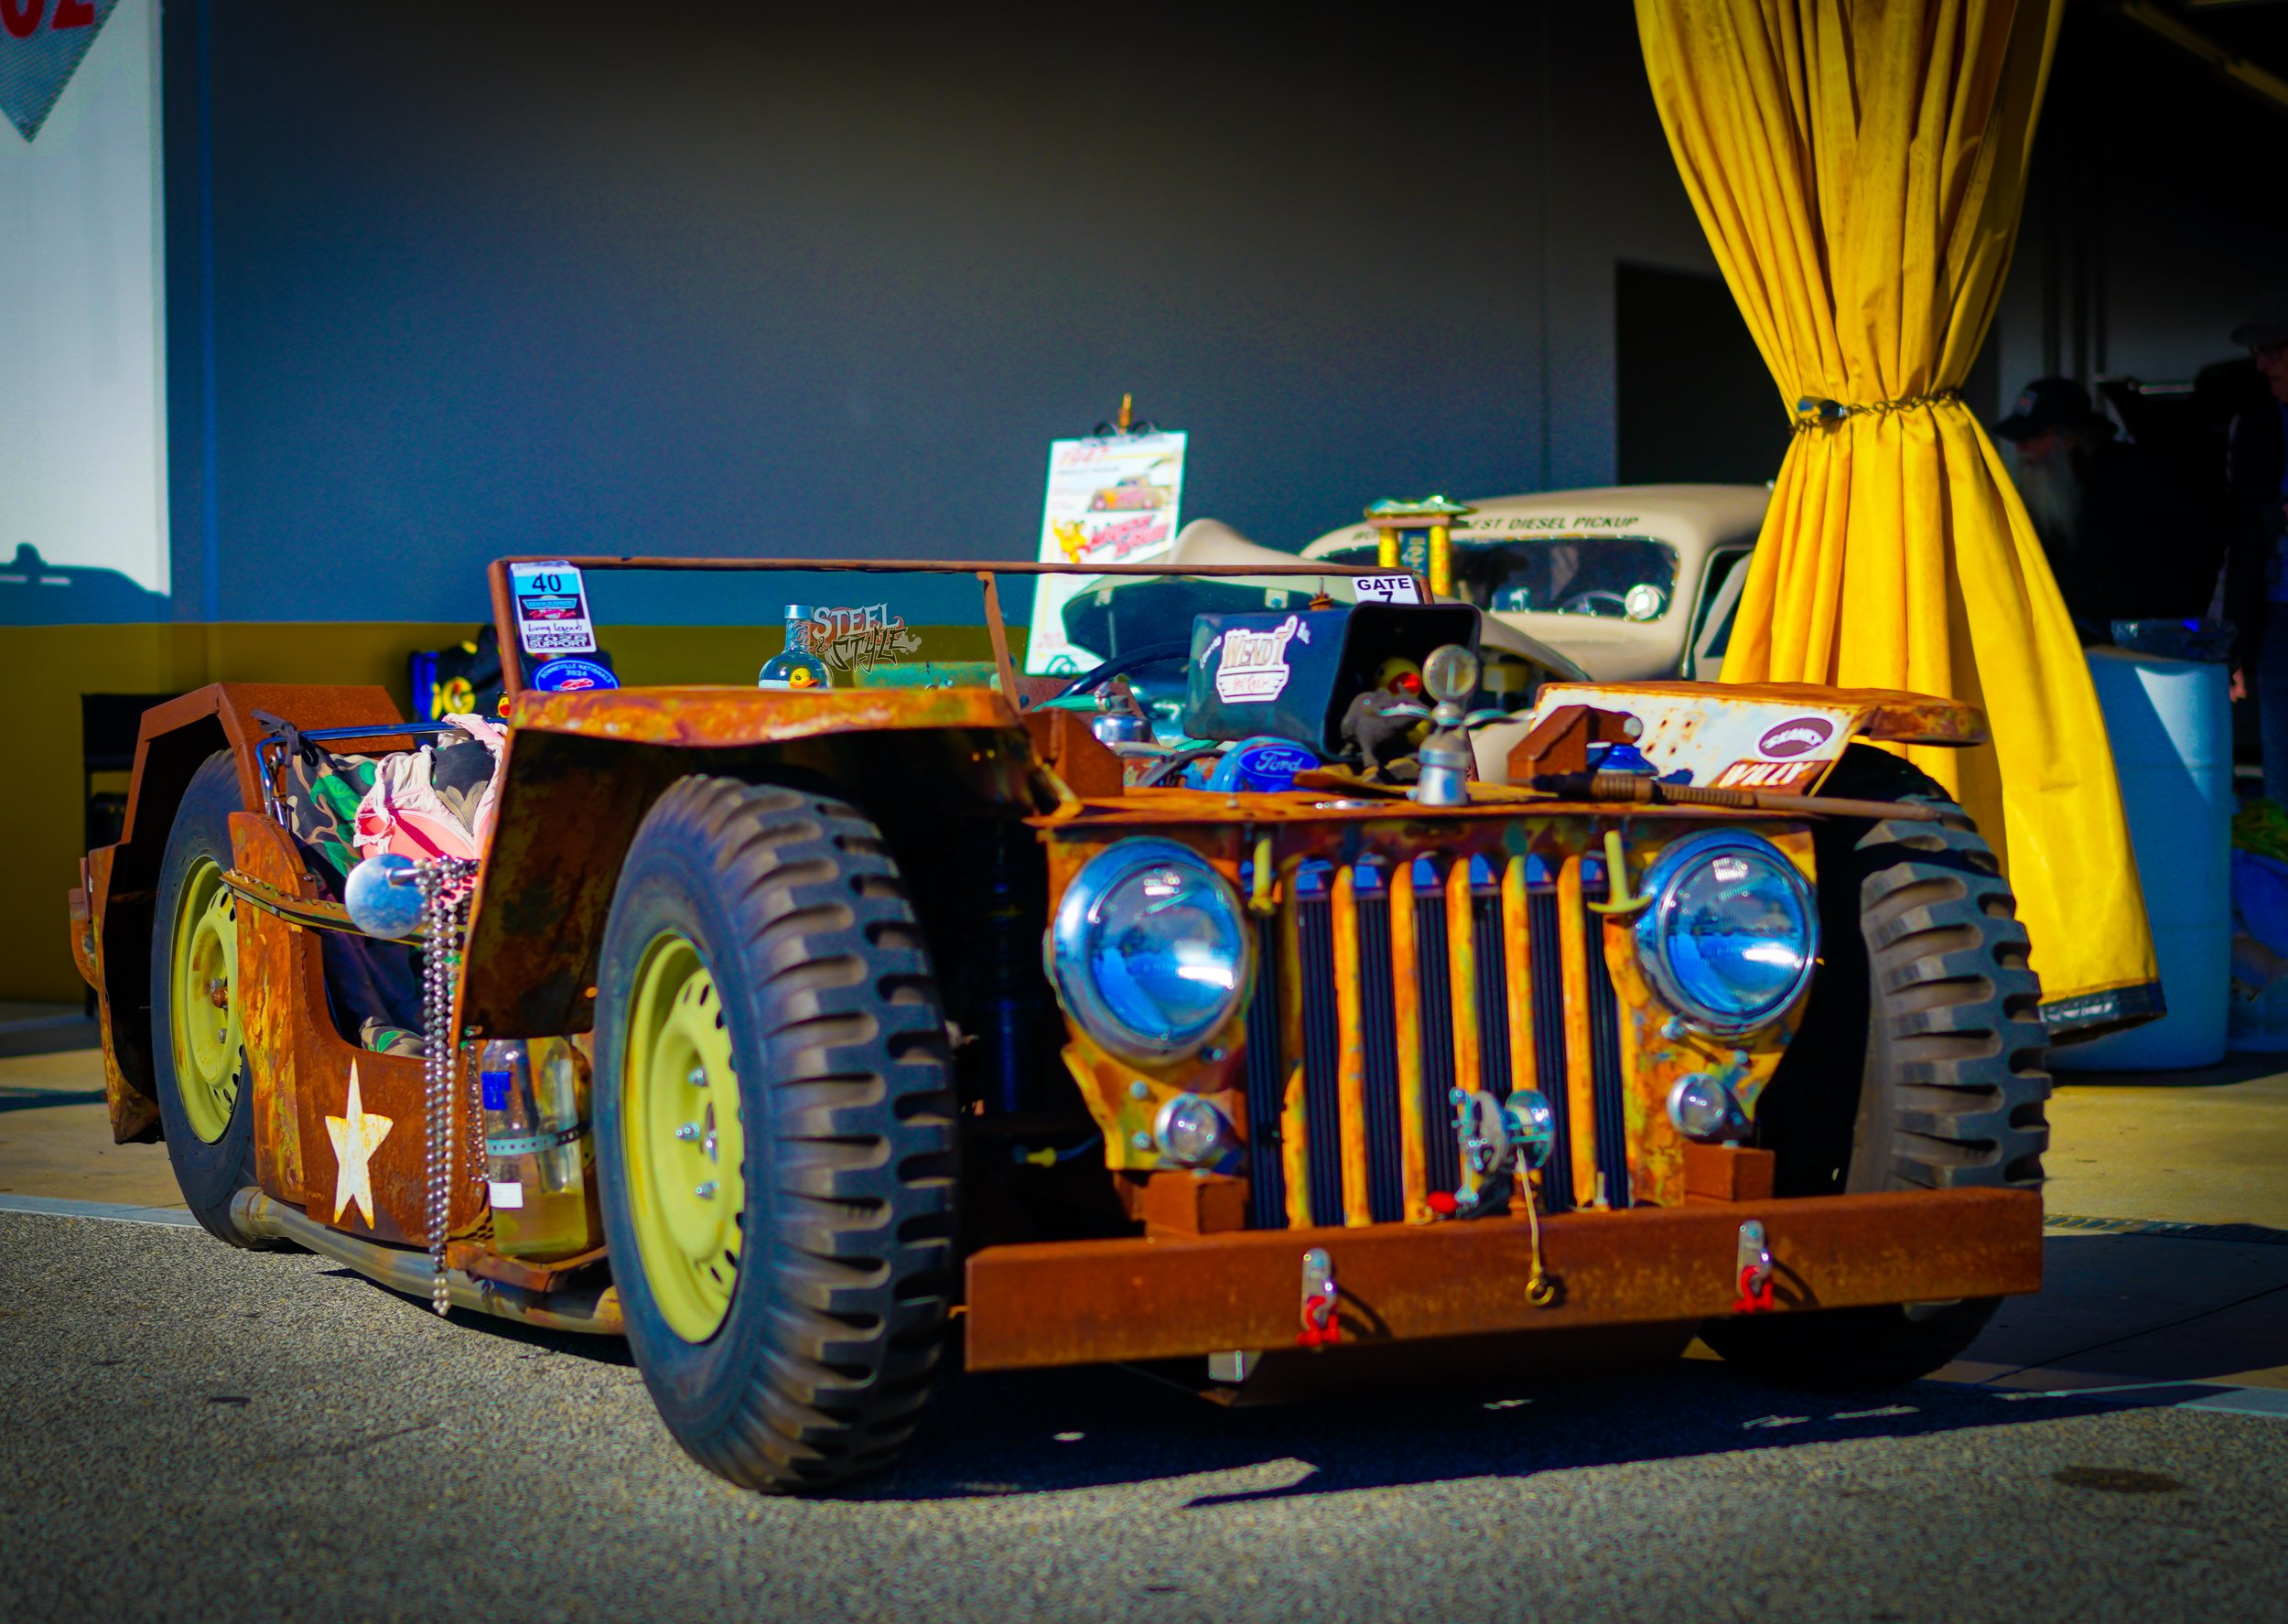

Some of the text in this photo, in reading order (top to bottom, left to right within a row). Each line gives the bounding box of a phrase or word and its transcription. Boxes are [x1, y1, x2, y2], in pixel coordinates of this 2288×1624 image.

[1508, 516, 1567, 530] DIESEL
[1572, 516, 1639, 528] PICKUP
[532, 573, 562, 593] 40
[1356, 577, 1411, 591] GATE
[1378, 591, 1394, 603] 7
[530, 640, 587, 649] SUPPORT
[1255, 750, 1304, 772] Ford
[1717, 761, 1814, 789] WILLY
